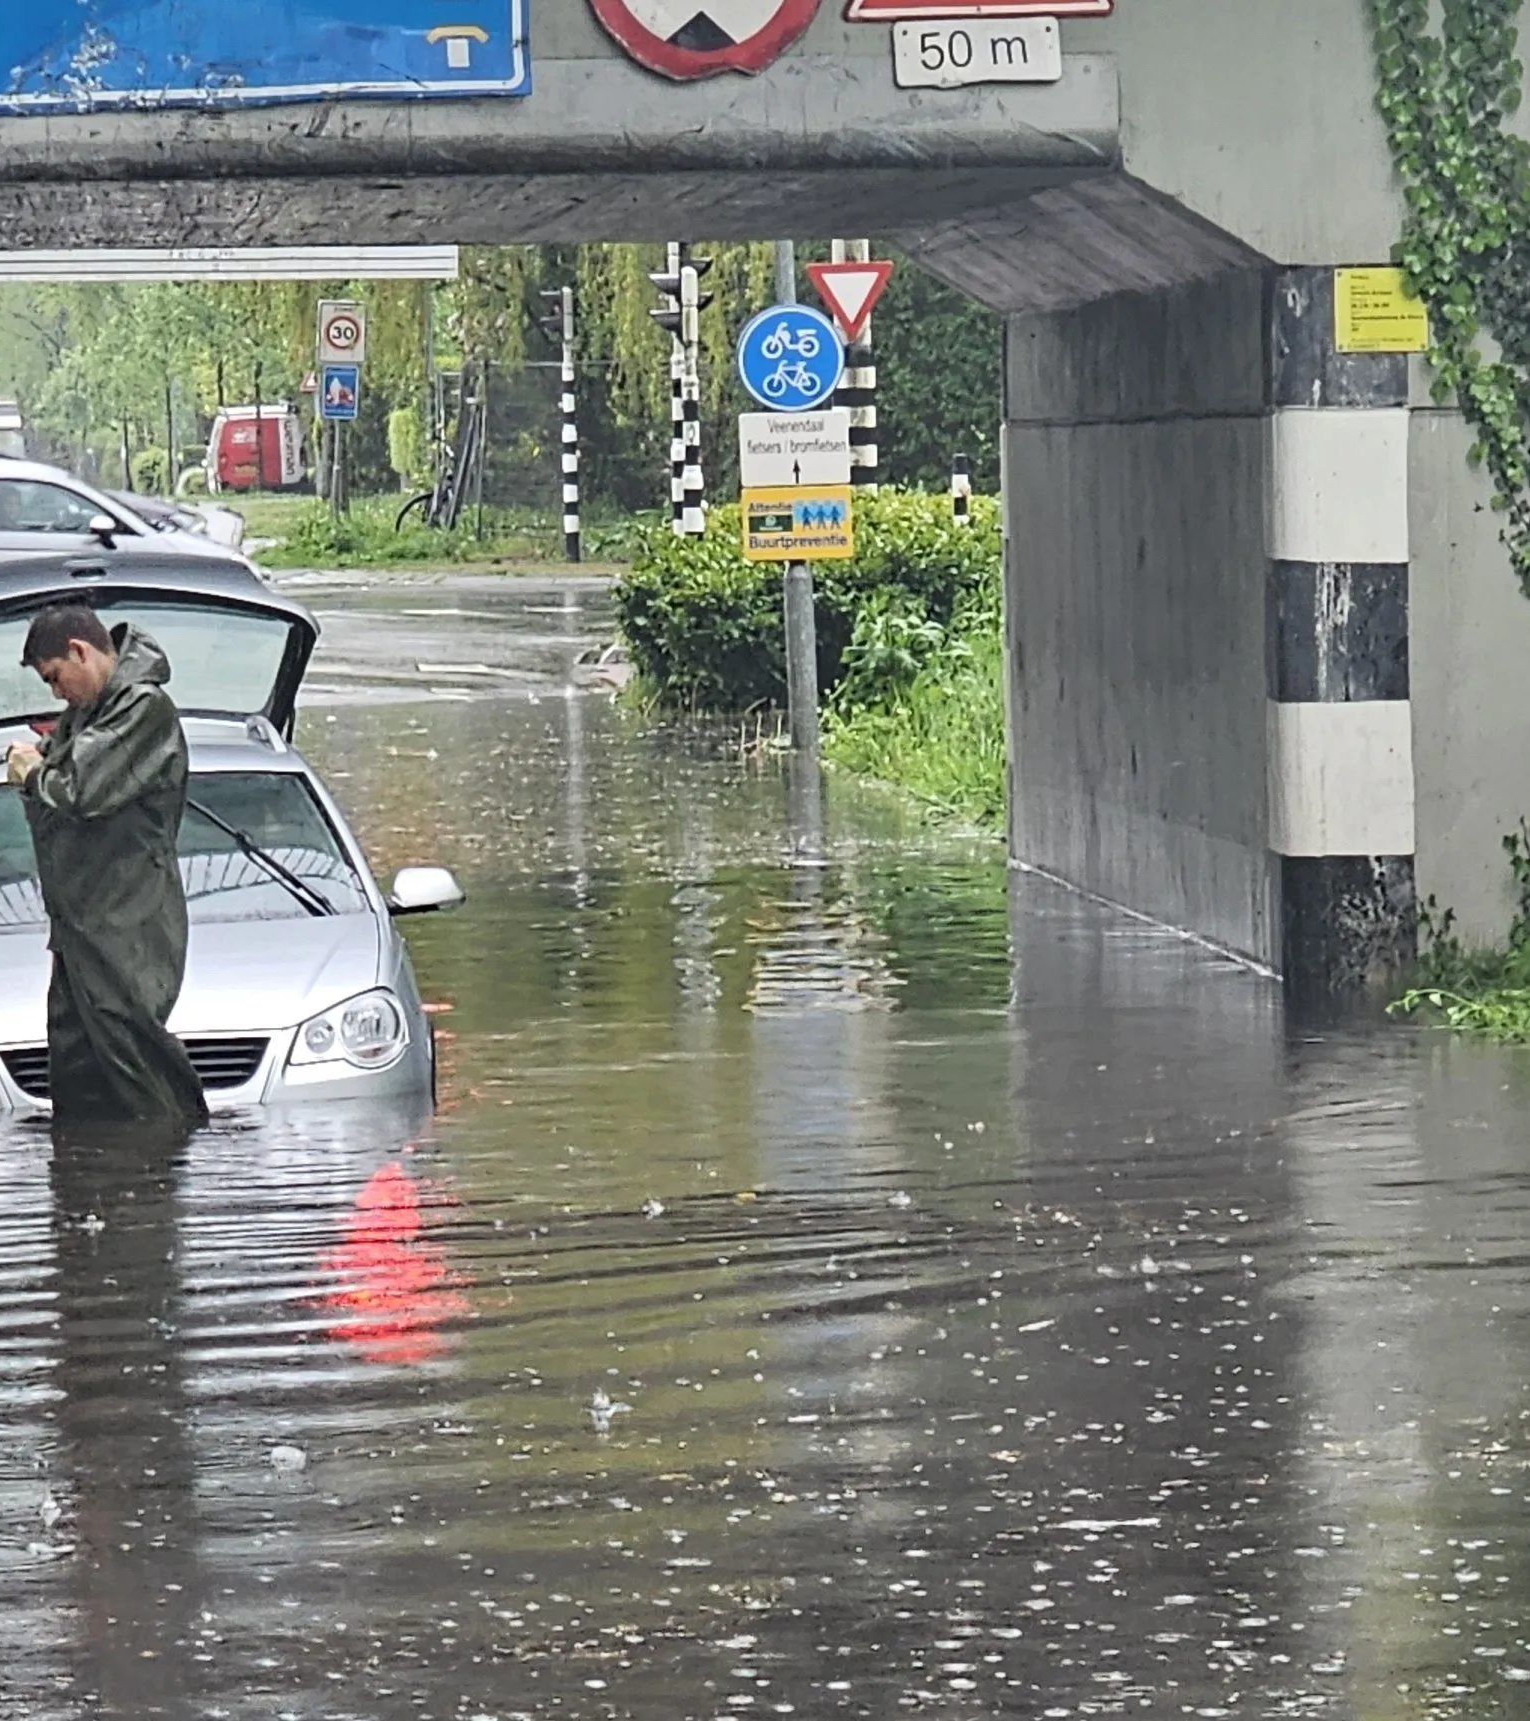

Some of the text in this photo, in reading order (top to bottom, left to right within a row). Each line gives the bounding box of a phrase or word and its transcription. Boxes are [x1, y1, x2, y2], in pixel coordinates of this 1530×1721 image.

[920, 30, 1028, 70] 50 m
[332, 326, 355, 340] 30
[767, 418, 824, 433] Veenendaal
[749, 535, 847, 550] Buurtpreventie
